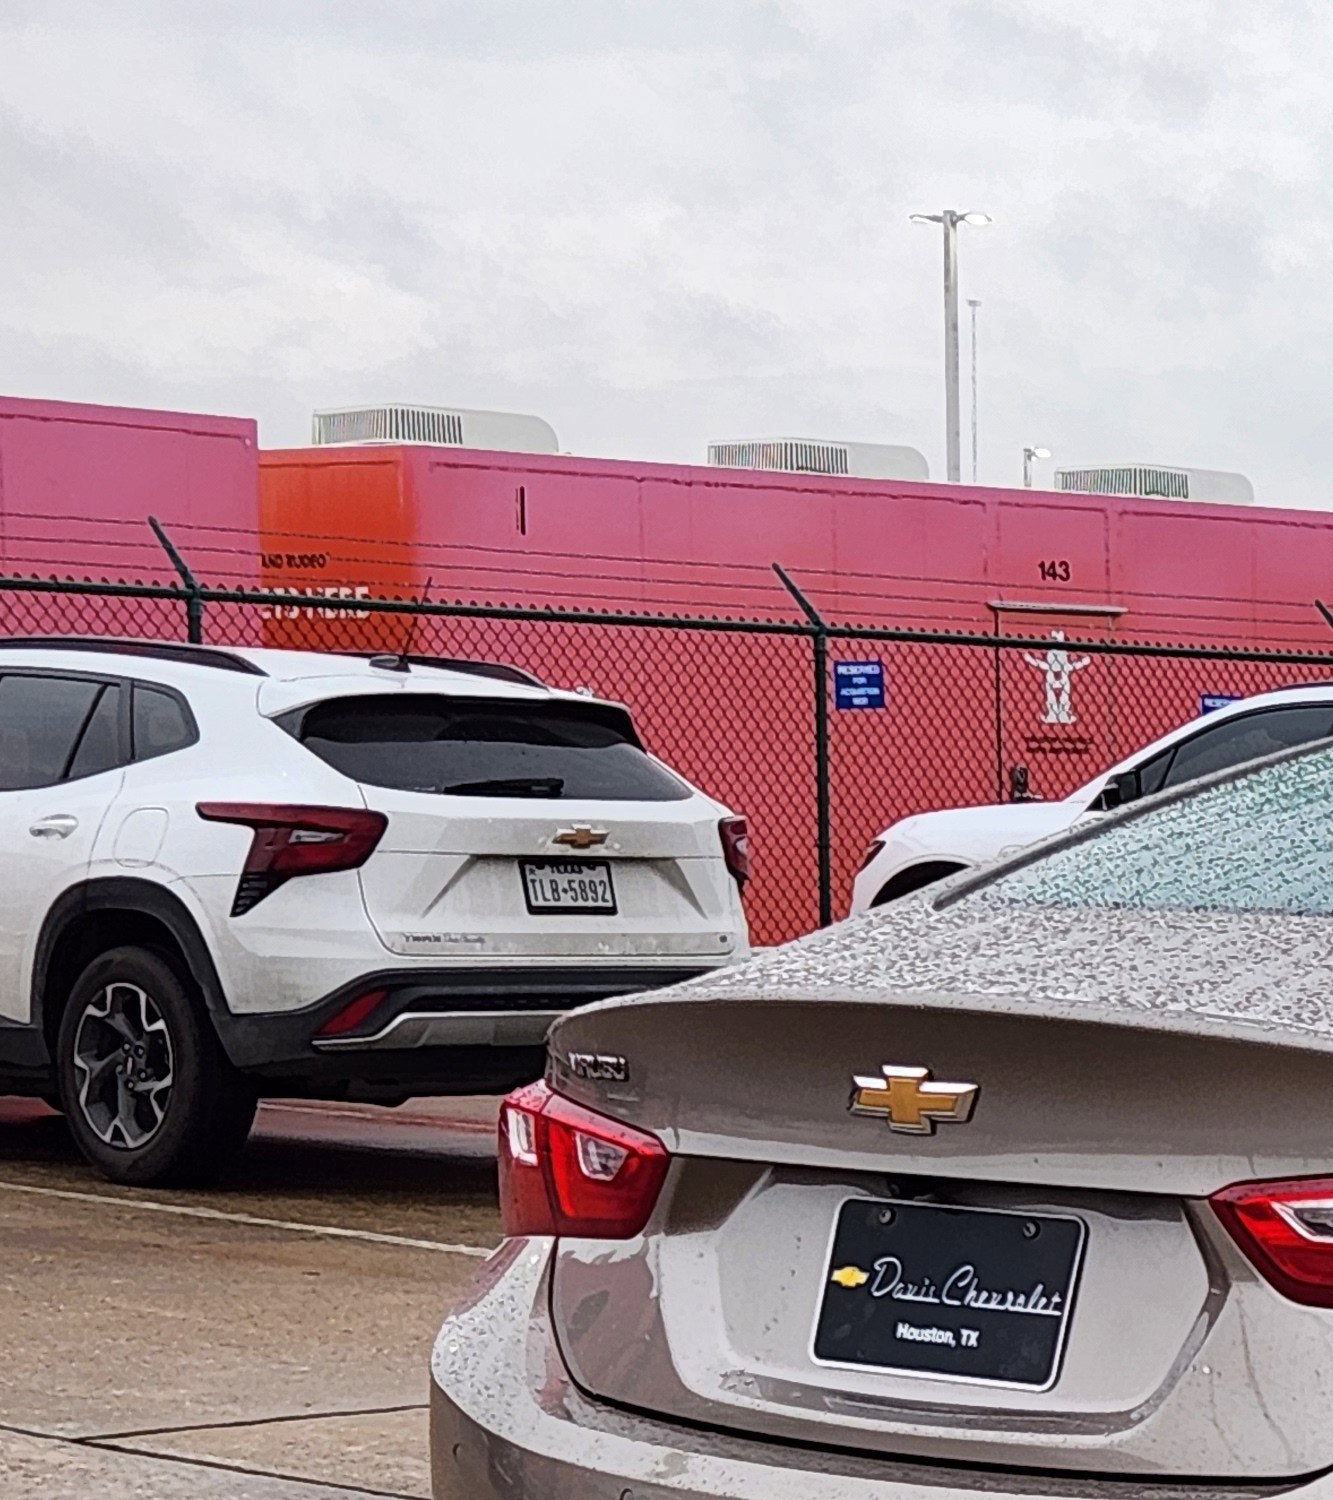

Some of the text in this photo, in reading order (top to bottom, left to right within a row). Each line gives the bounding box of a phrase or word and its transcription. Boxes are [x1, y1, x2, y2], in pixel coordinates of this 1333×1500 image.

[1038, 560, 1071, 582] 143
[870, 1256, 1062, 1316] Davis Chevrolet
[896, 1321, 980, 1348] Houston, TX
